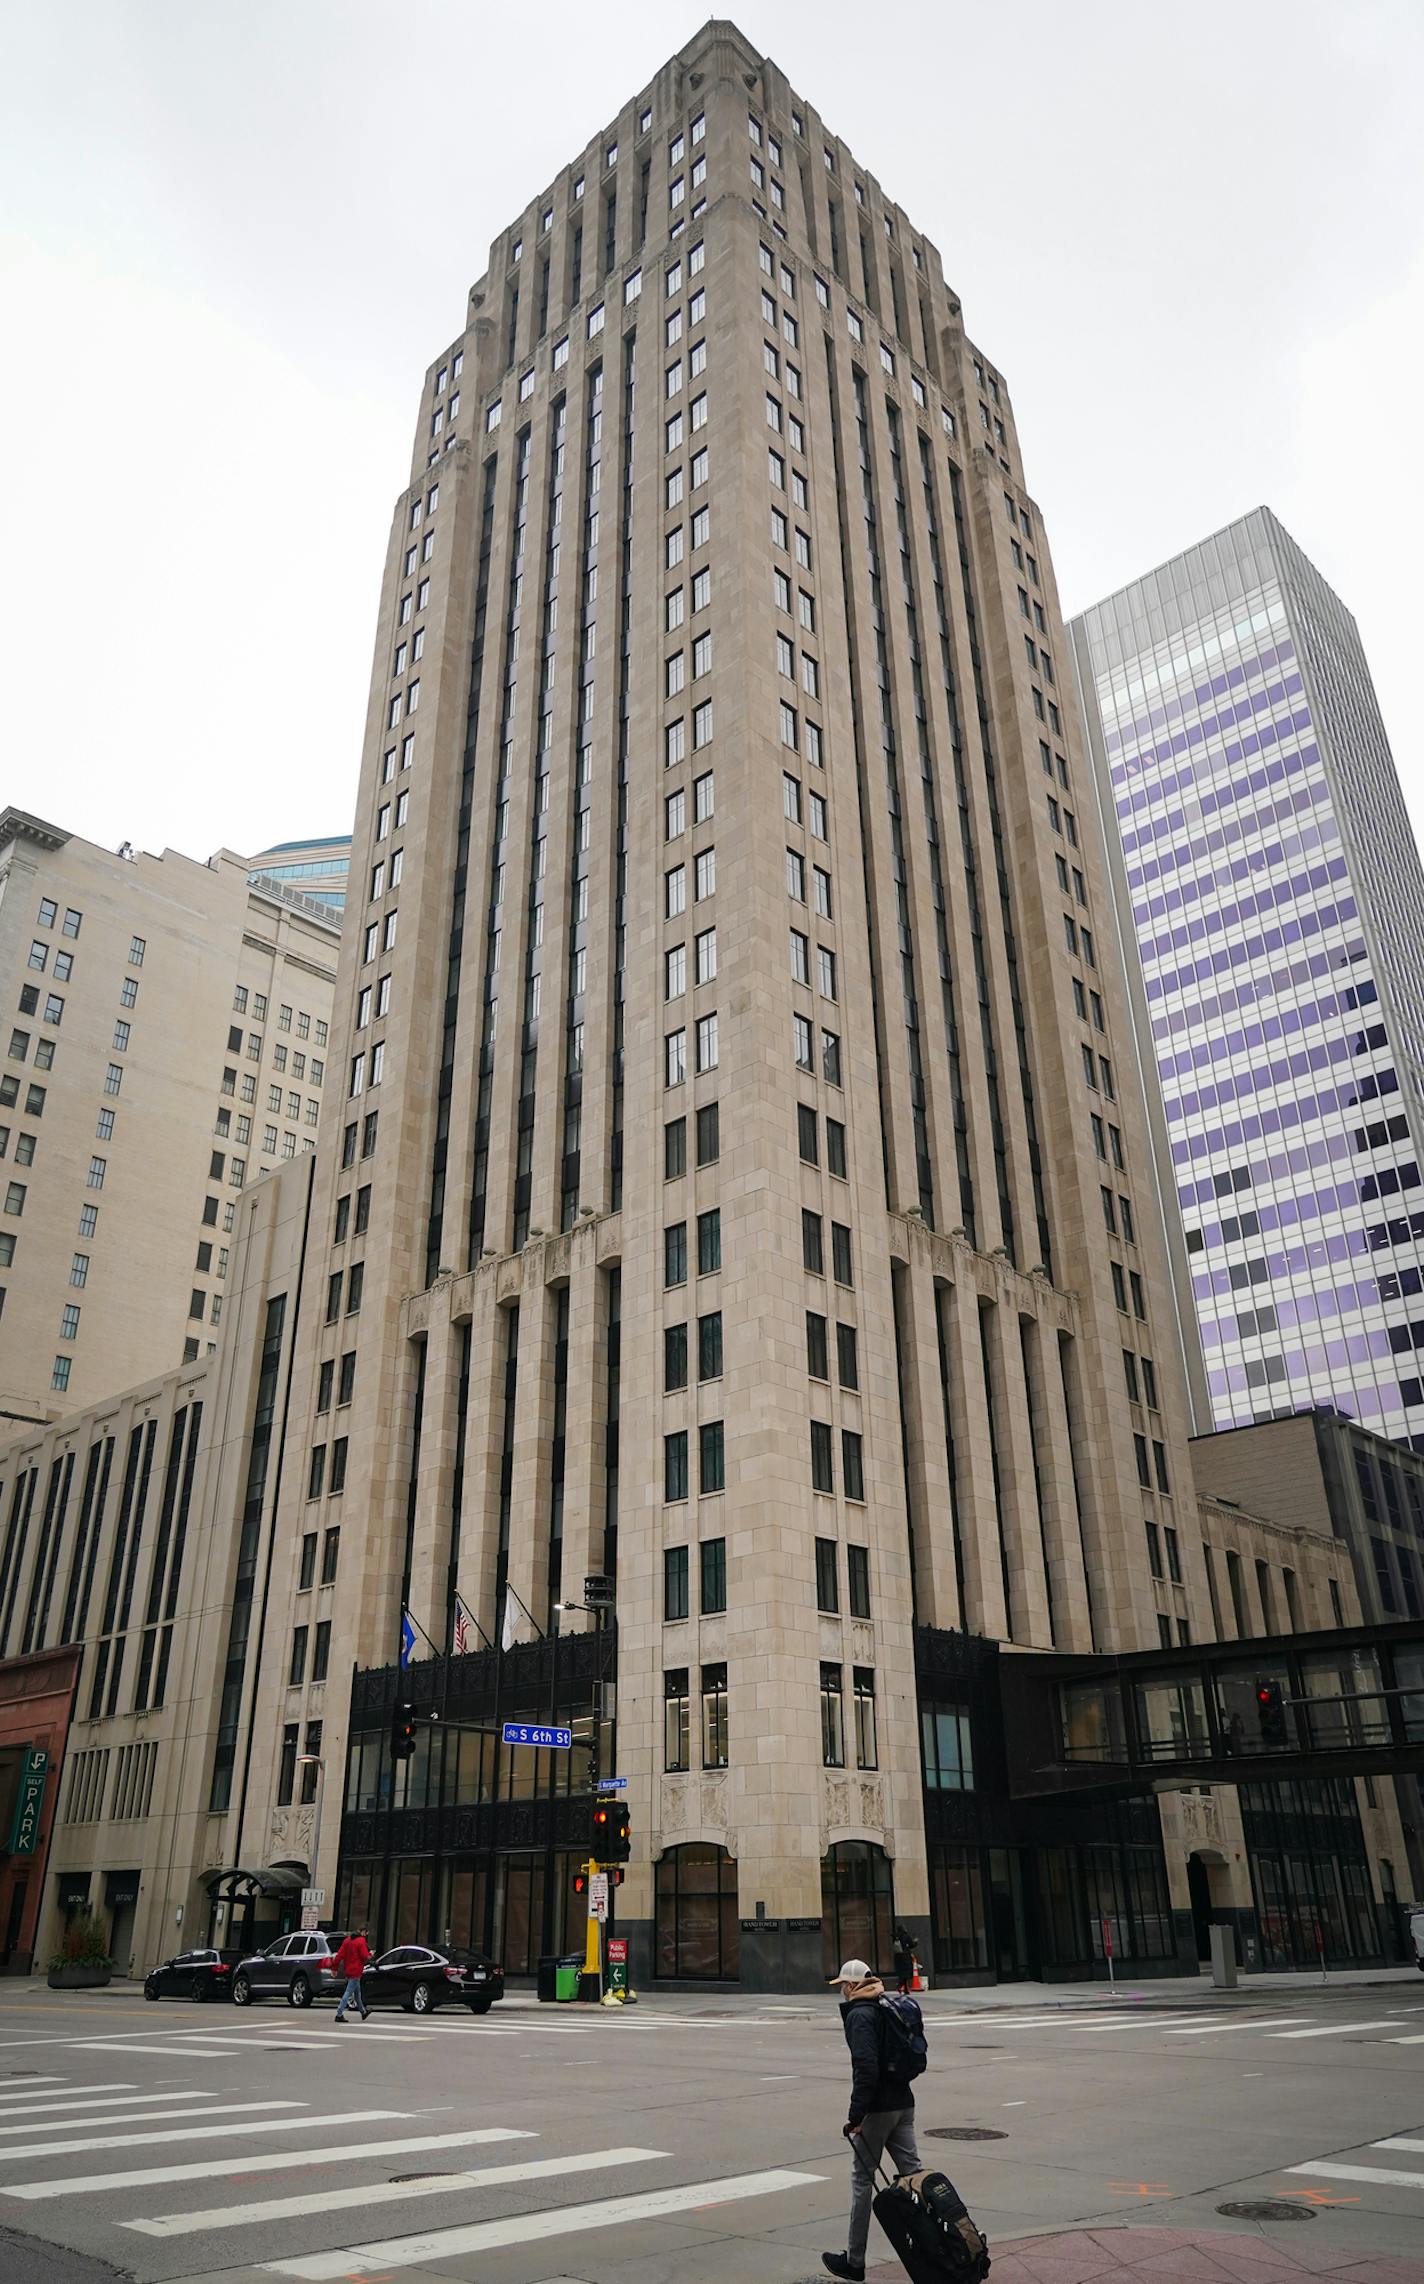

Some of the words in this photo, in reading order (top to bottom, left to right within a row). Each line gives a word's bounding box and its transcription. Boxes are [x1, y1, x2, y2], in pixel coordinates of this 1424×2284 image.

[520, 1729, 528, 1741] S
[532, 1730, 552, 1742] 6th
[556, 1732, 569, 1744] St
[18, 1787, 38, 1849] PARK
